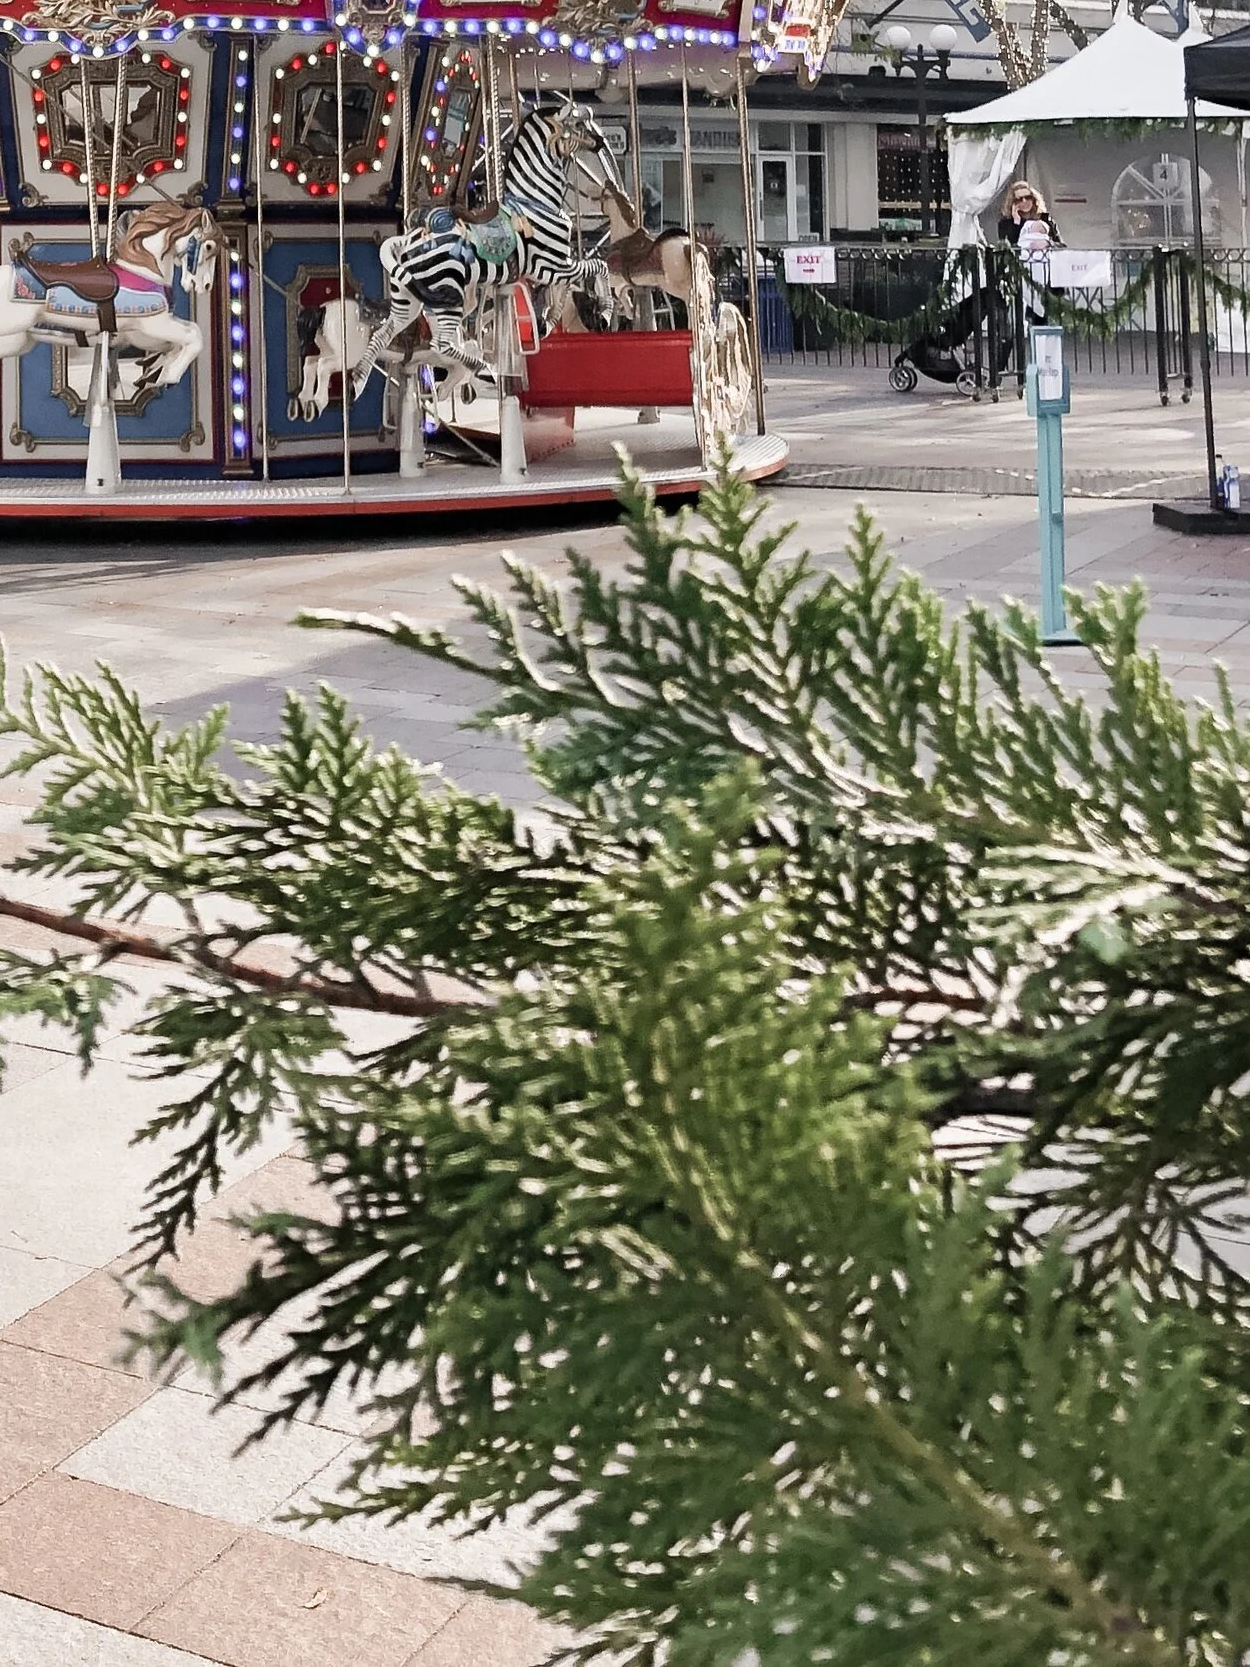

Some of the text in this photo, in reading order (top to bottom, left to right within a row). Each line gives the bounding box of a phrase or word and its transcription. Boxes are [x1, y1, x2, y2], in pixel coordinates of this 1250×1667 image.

[1160, 169, 1167, 181] 4
[796, 255, 822, 264] EXIT
[1071, 264, 1087, 272] EXIT
